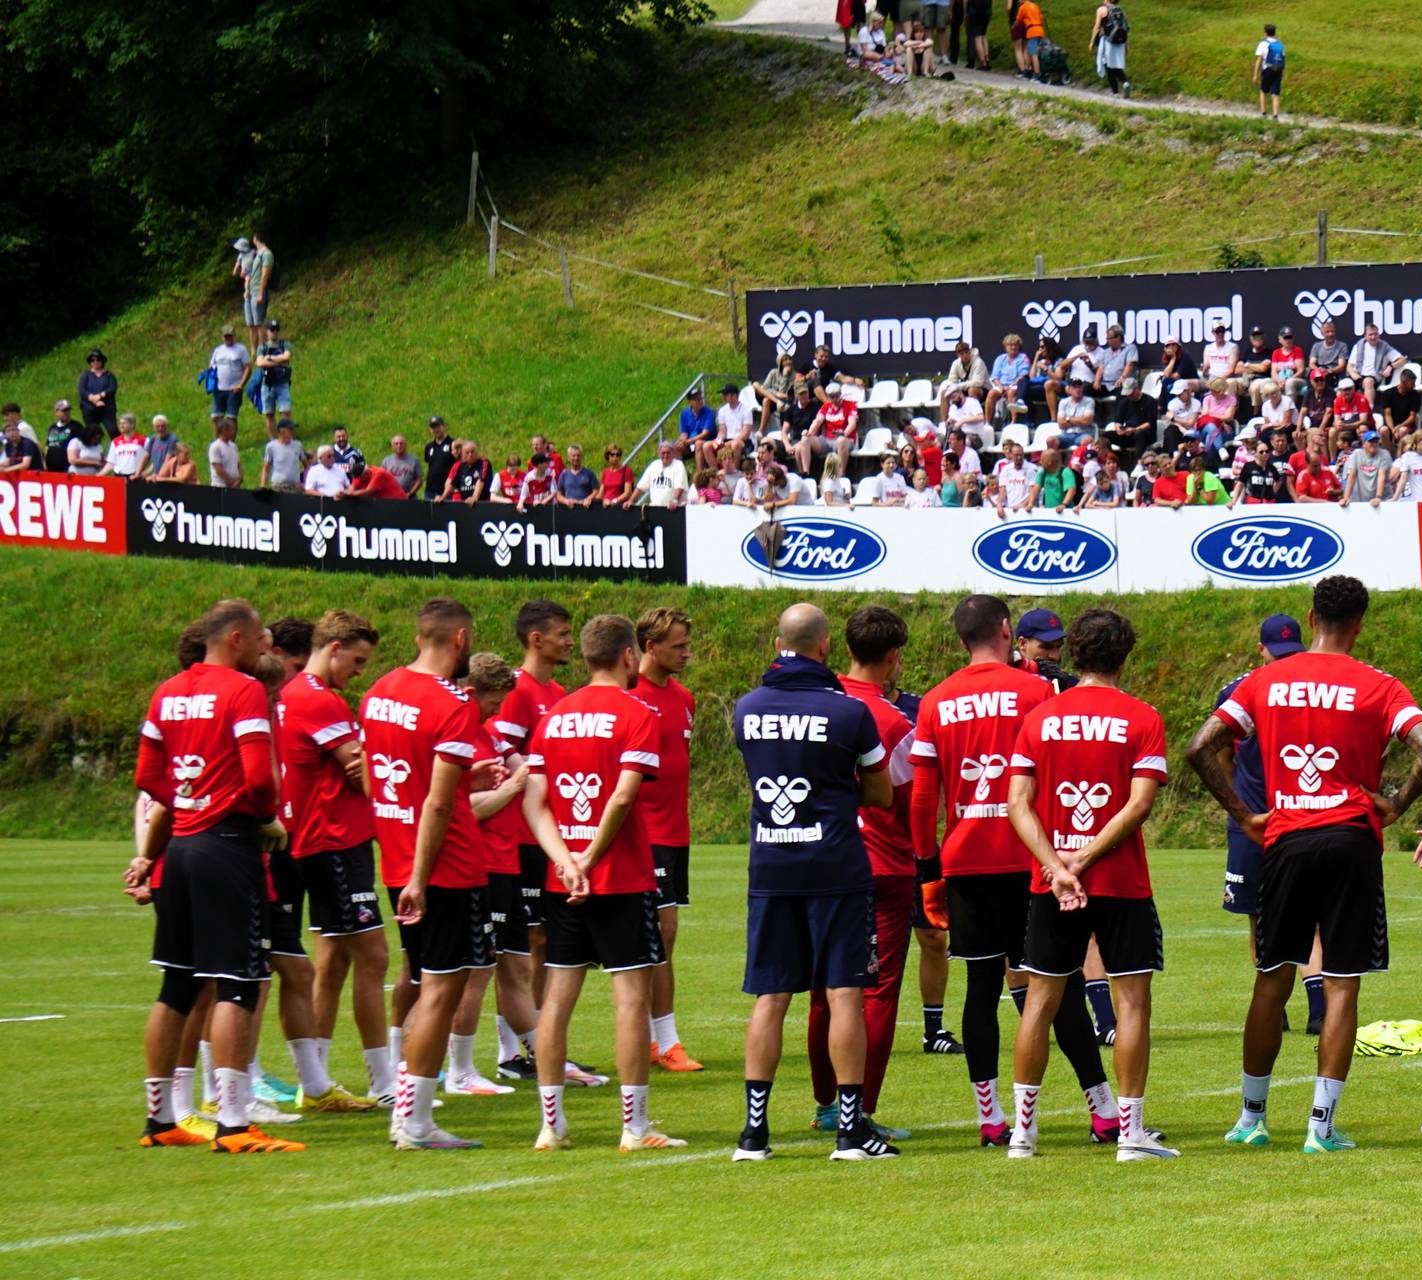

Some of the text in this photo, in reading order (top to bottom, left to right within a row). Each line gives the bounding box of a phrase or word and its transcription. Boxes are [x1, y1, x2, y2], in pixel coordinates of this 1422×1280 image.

[814, 304, 972, 355] hummel
[1079, 294, 1242, 348] hummel
[0, 480, 106, 543] REWE
[177, 511, 280, 553] hummel
[338, 520, 457, 564] hummel
[526, 523, 664, 569] hummel
[773, 526, 856, 571] Ford
[1000, 531, 1085, 575] Ford
[1223, 525, 1311, 570] Ford
[160, 694, 217, 721] REWE
[938, 691, 1019, 726] REWE
[1268, 682, 1357, 712] REWE
[365, 696, 420, 731] REWE
[545, 713, 617, 739] REWE
[744, 714, 829, 743] REWE
[1041, 715, 1129, 744] REWE
[955, 802, 1008, 819] humme
[1275, 789, 1349, 810] hummel
[558, 820, 599, 841] humm
[756, 822, 823, 843] hummel
[1053, 829, 1096, 850] hum
[522, 888, 541, 897] EWE
[492, 912, 507, 922] WE
